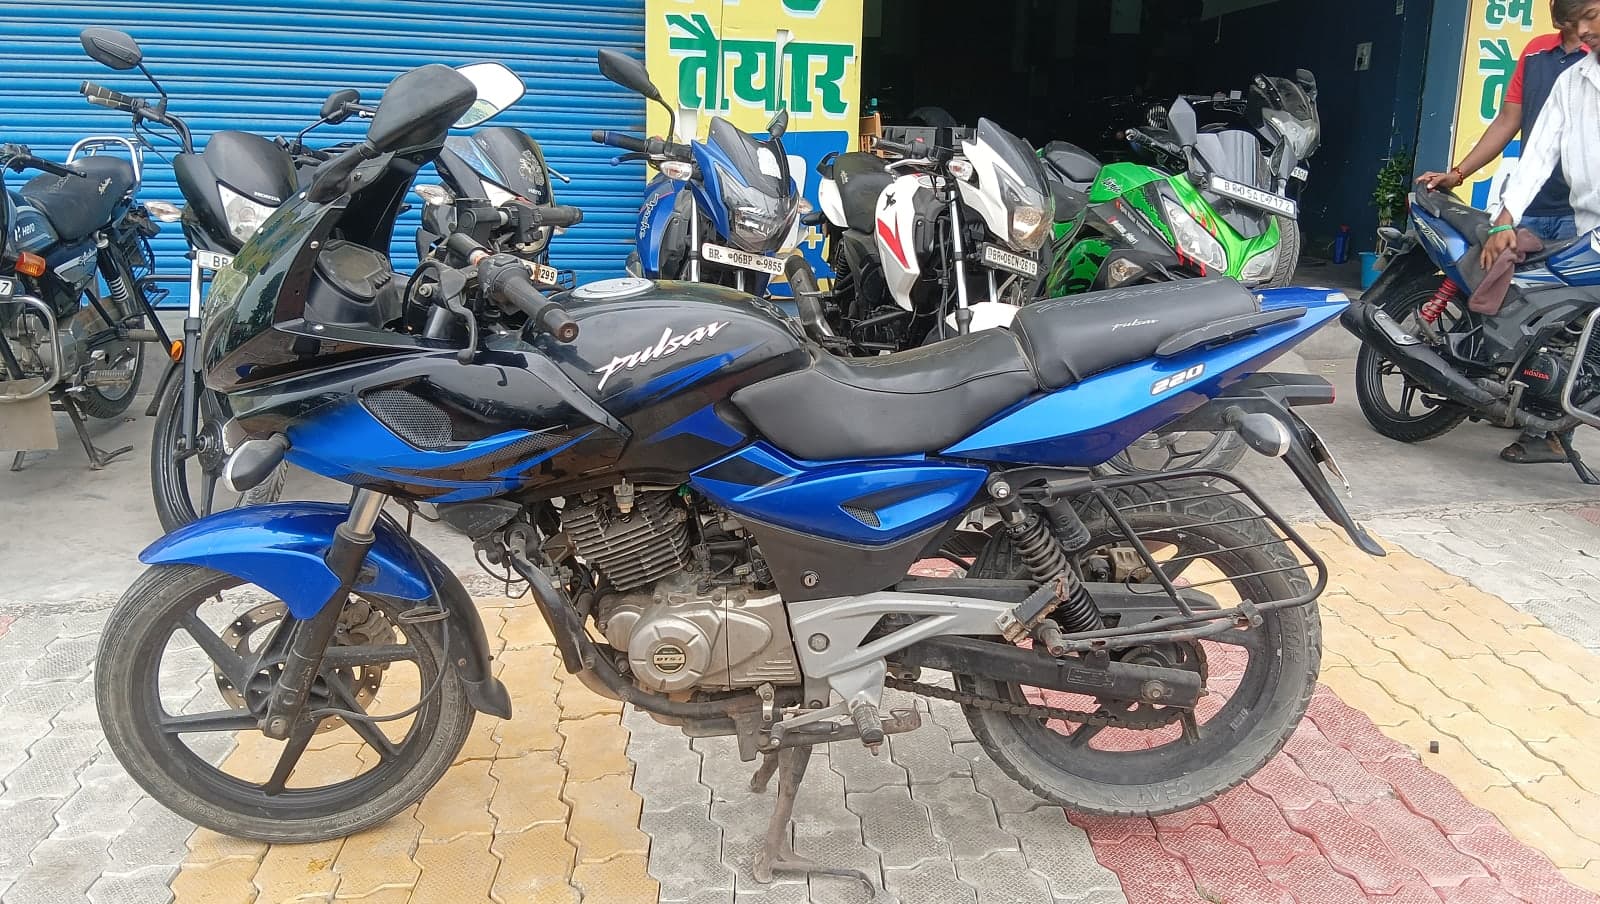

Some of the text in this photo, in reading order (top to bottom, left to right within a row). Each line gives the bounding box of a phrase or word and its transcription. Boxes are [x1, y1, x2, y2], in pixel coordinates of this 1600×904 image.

[665, 14, 854, 113] तैयार
[22, 222, 36, 237] Hero
[538, 268, 555, 282] 299
[1151, 364, 1204, 395] 220
[1522, 369, 1551, 381] HONDA
